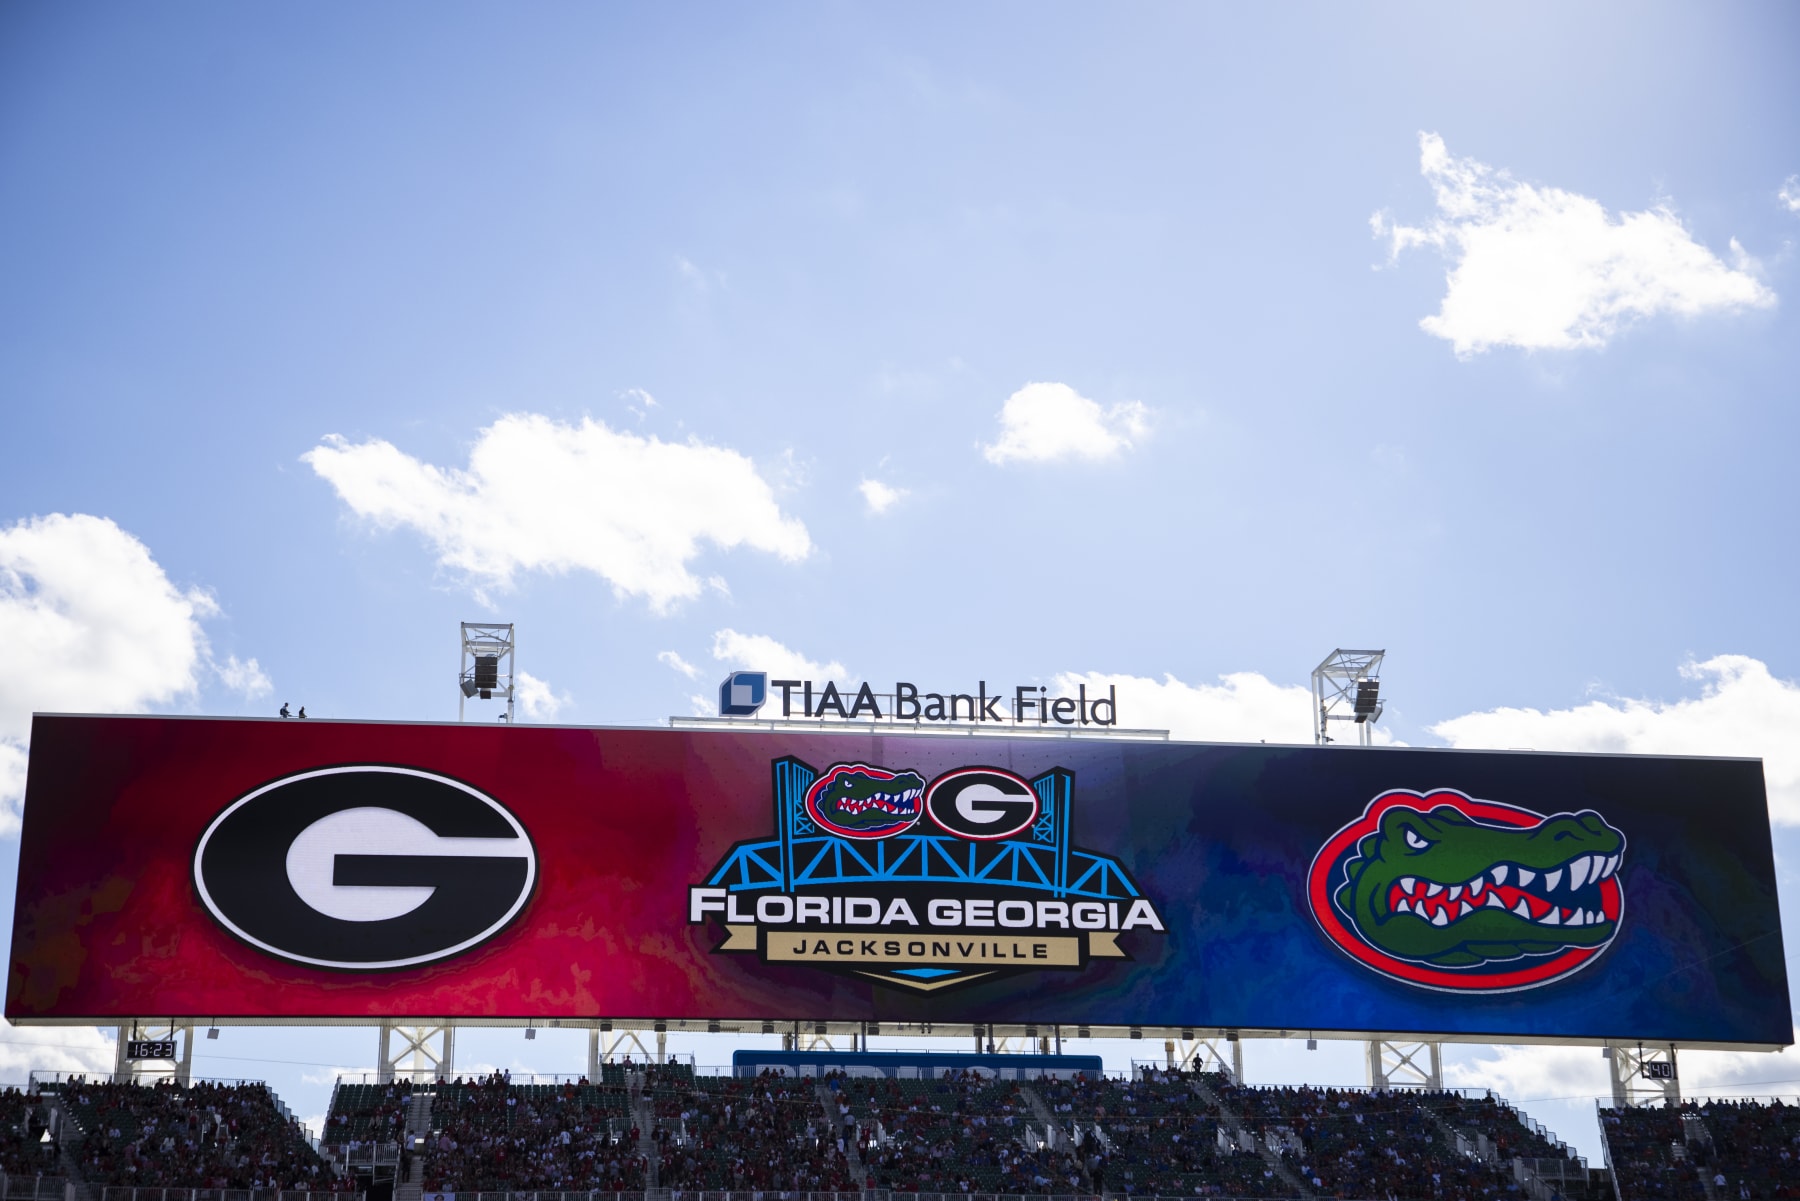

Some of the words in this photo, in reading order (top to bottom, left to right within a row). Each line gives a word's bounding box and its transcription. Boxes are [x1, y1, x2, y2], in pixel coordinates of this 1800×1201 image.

[771, 679, 883, 719] TIAA
[896, 680, 1003, 722] Bank
[1016, 684, 1117, 726] Field
[954, 783, 1034, 824] G
[690, 887, 919, 926] FLORIDA
[927, 899, 1165, 931] GEORGIA
[792, 939, 1048, 959] JACKSONVILLE
[134, 1043, 173, 1057] 16:23
[1652, 1063, 1670, 1077] 40
